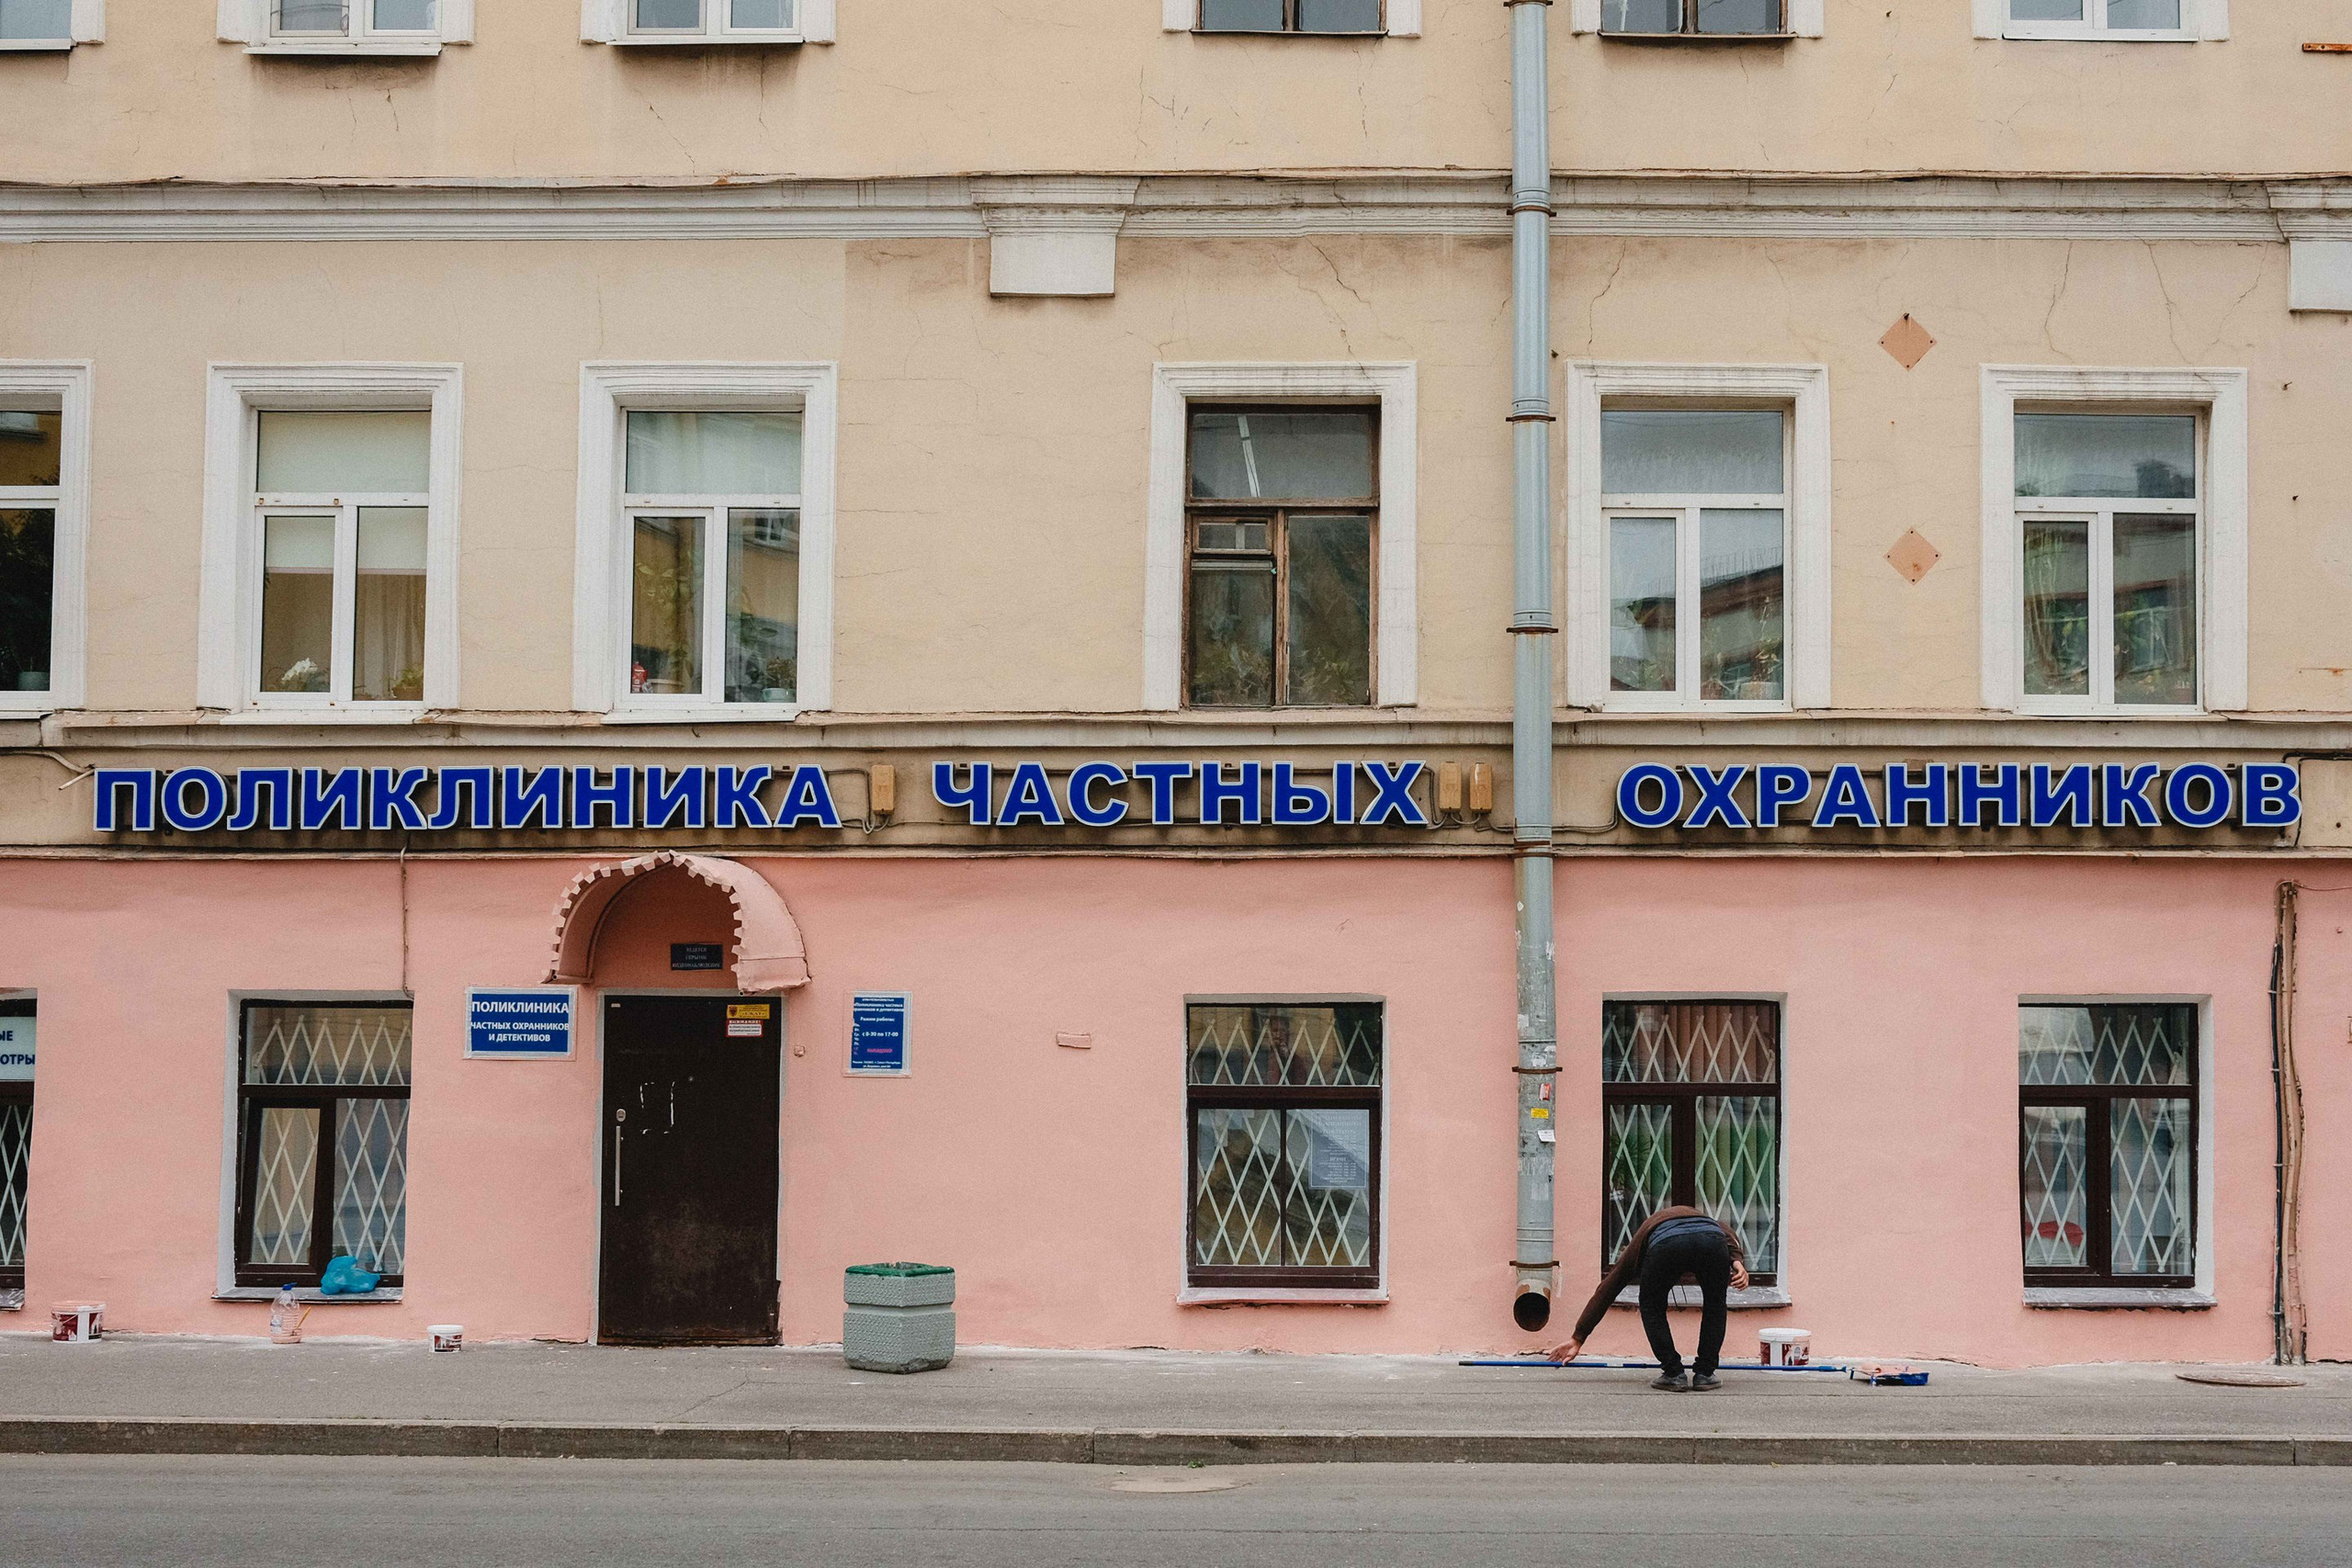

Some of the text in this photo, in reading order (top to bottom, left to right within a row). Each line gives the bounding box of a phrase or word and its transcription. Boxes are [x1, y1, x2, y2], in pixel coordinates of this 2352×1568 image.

[93, 760, 2303, 832] ПОЛИКЛИНИКА ЧАСТНЫХ ОХРАННИКОВ
[471, 1001, 569, 1013] ПОЛИКЛИНИКА
[471, 1021, 569, 1031] ЧАСТНЫХ ОХРАННИКОВ
[496, 1033, 551, 1043] ДЕТЕКТИВОВ
